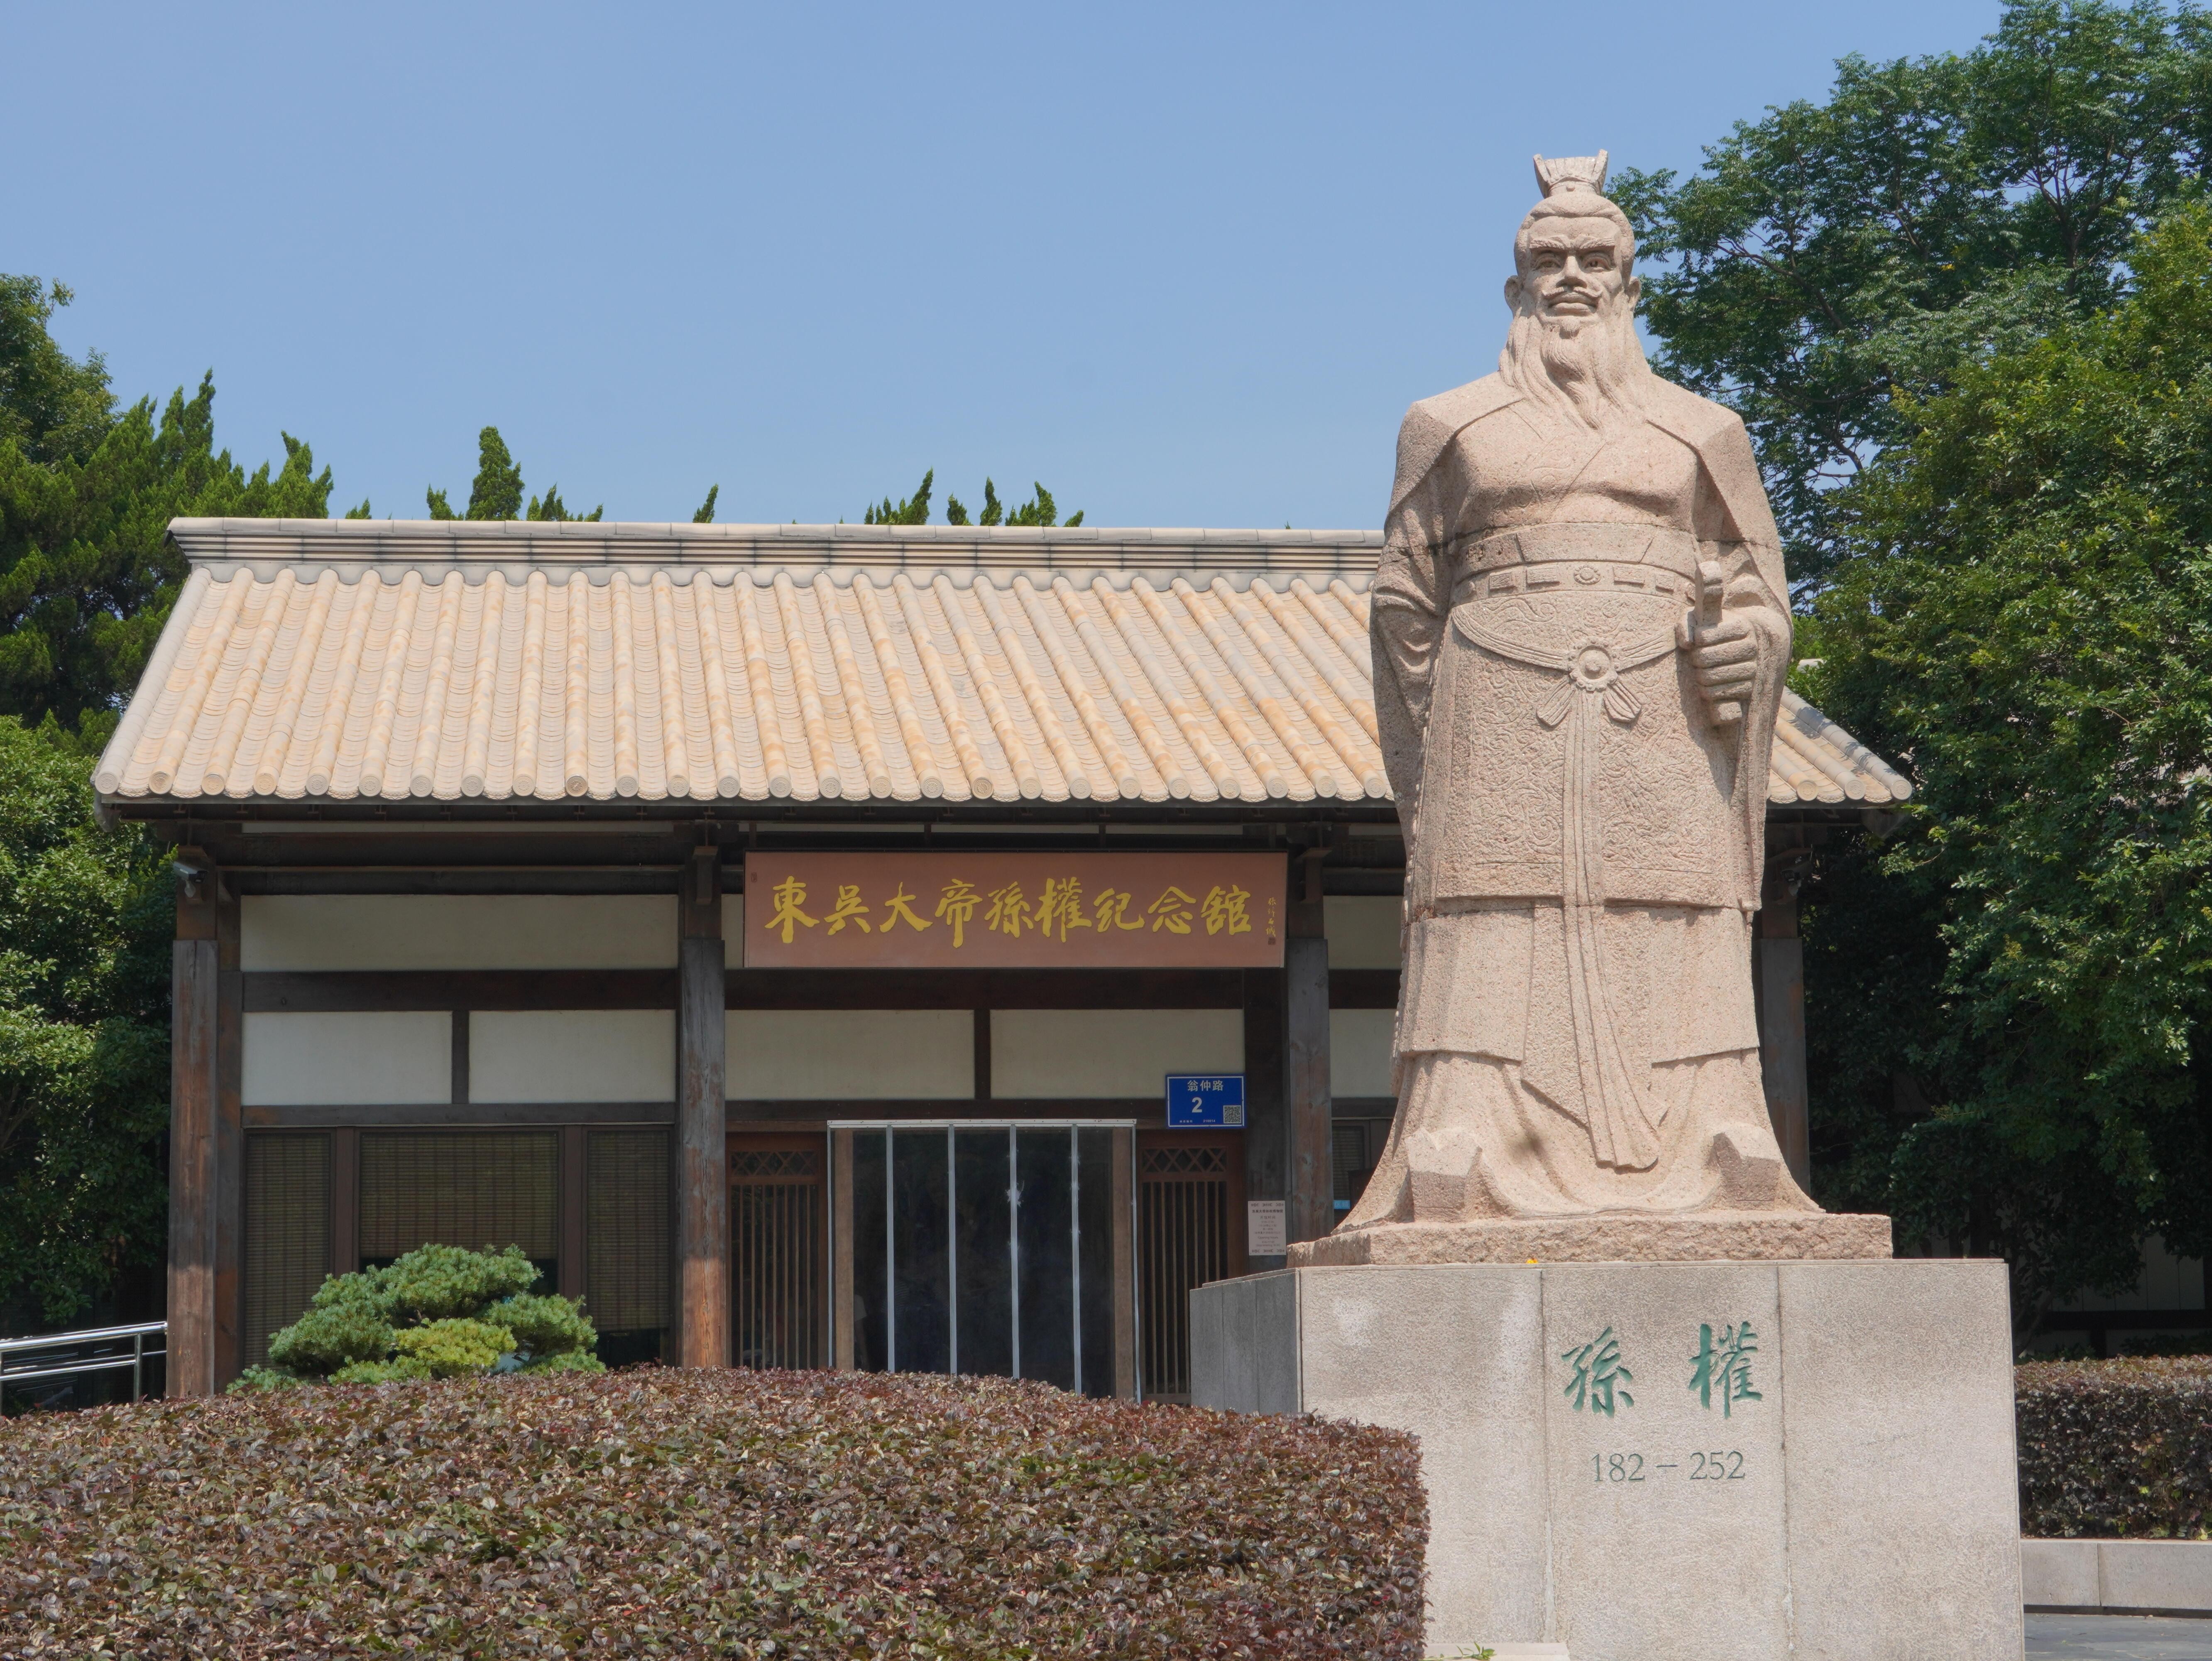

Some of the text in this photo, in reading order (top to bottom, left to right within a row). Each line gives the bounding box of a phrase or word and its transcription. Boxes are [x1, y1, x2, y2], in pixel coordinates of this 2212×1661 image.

[1187, 1080, 1224, 1092] 翁仲路
[1192, 1097, 1202, 1113] 2
